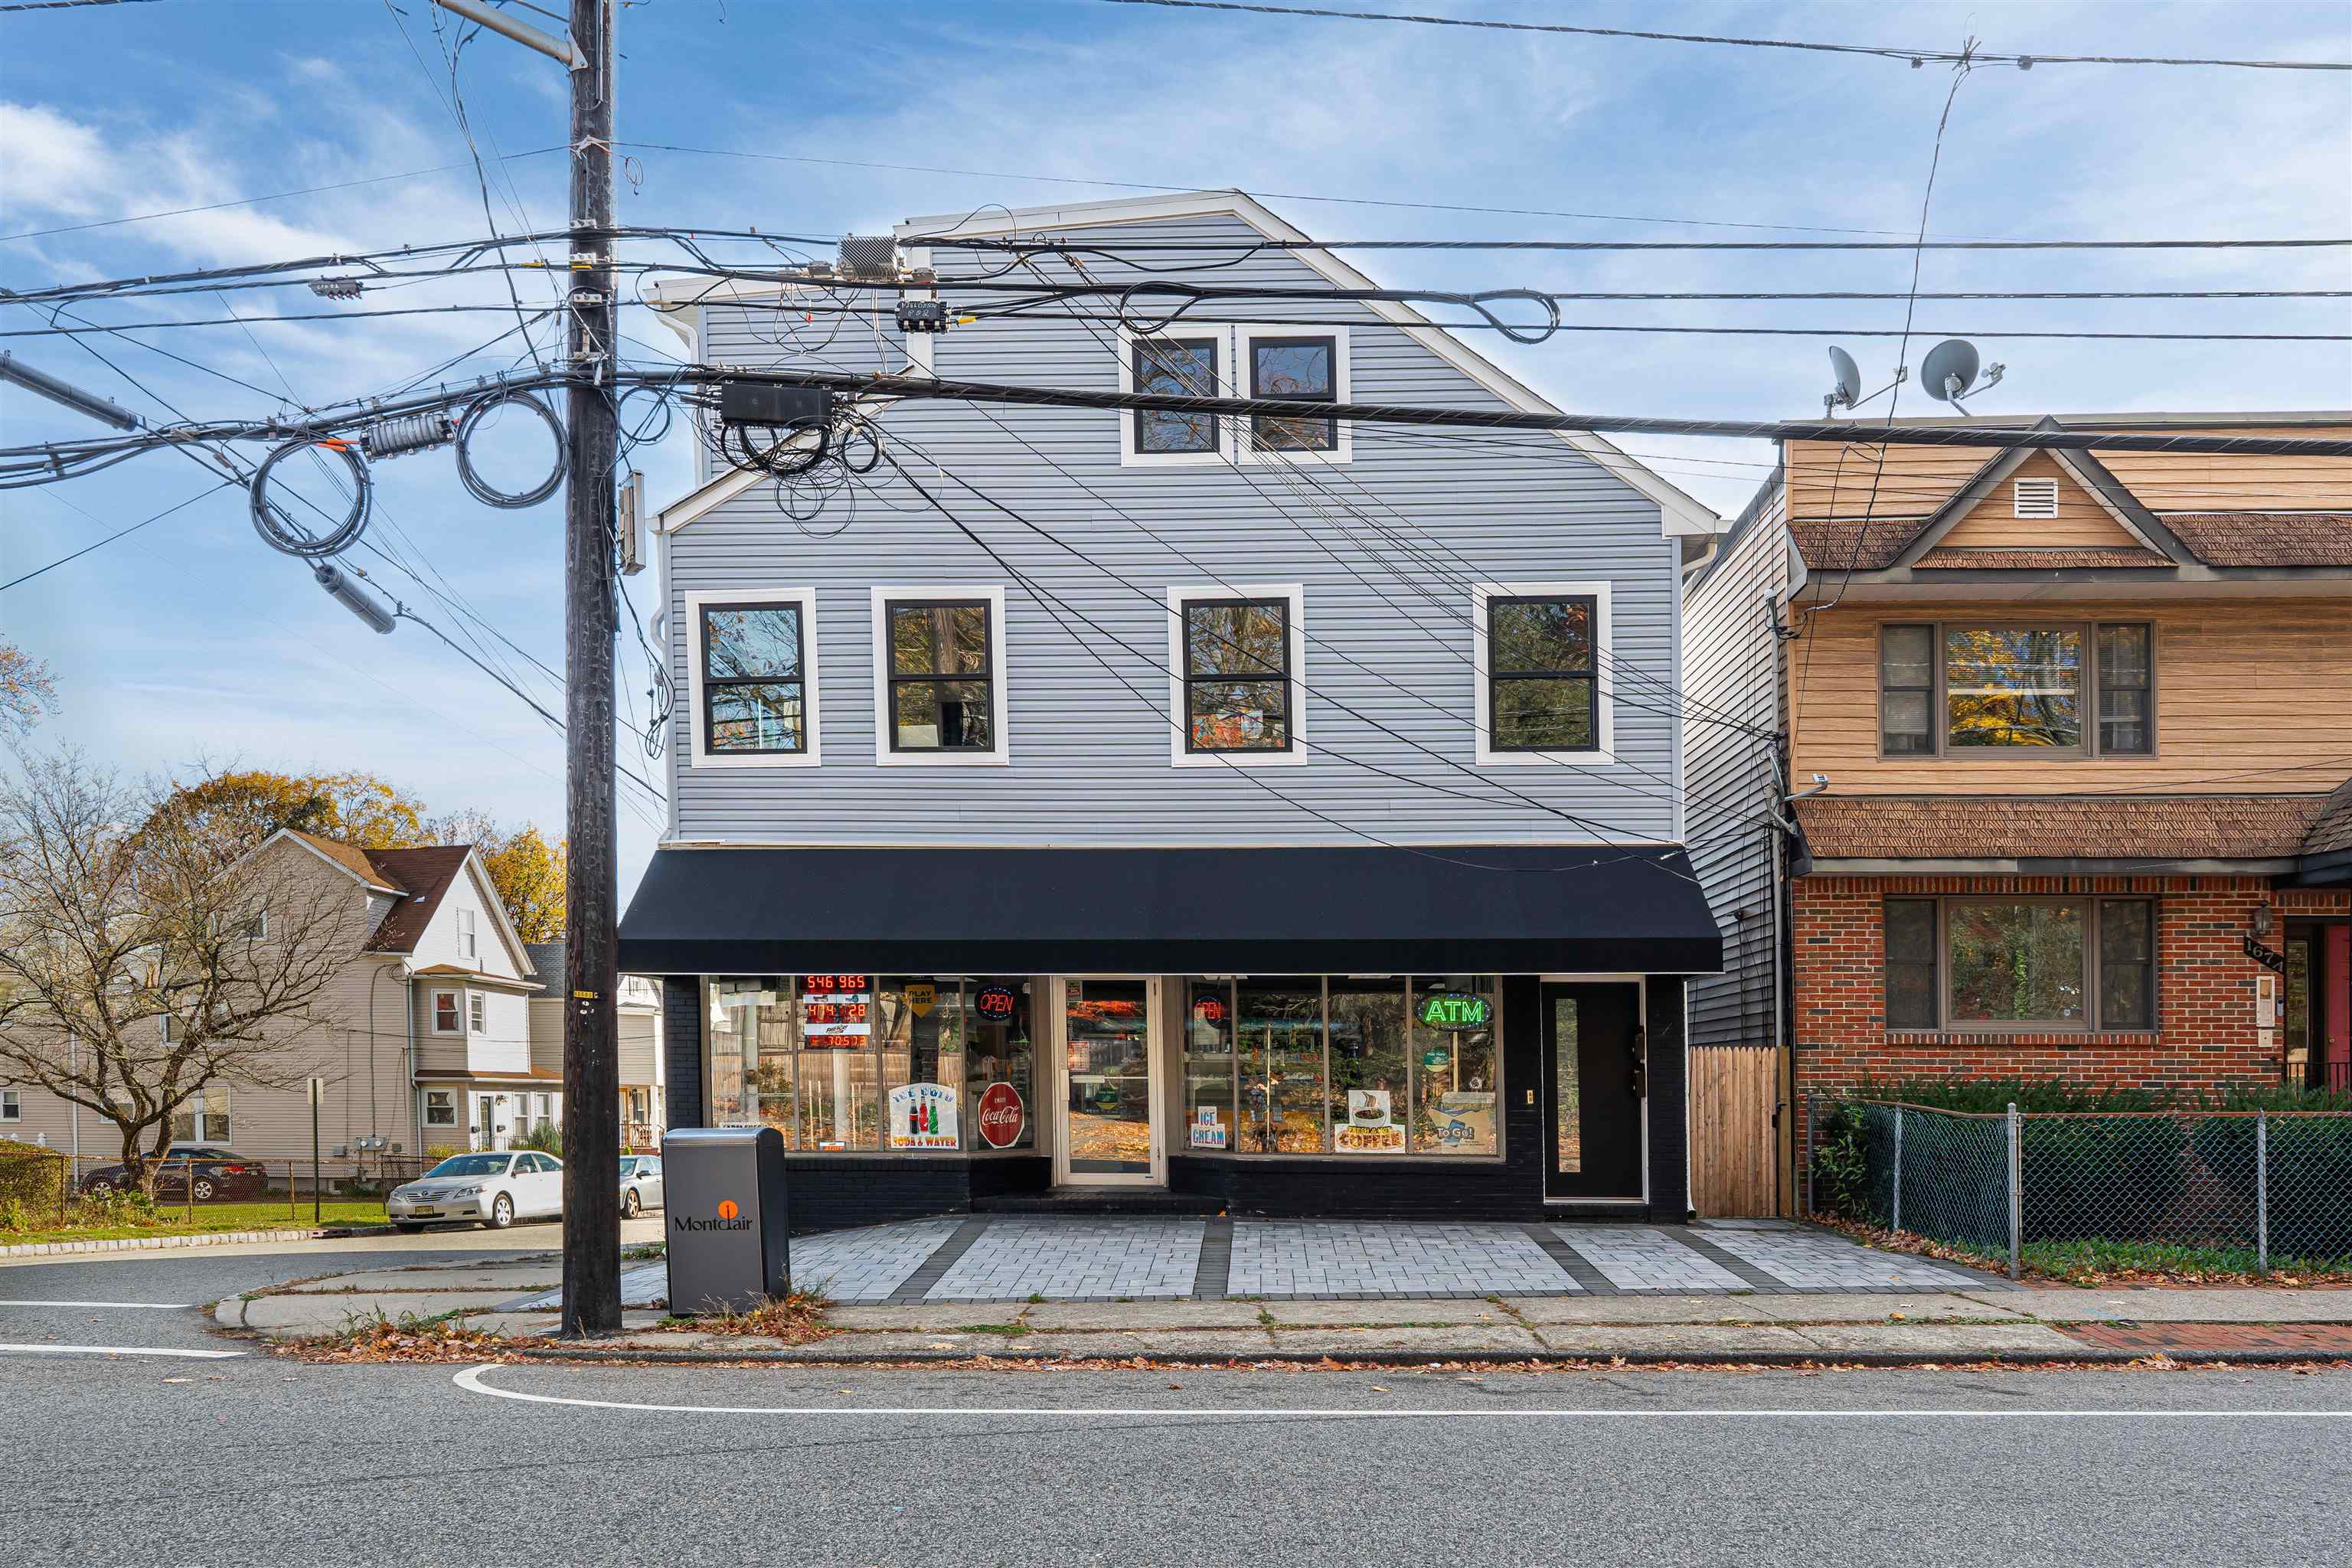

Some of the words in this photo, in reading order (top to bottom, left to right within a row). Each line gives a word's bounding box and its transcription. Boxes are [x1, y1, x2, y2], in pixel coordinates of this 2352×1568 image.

[808, 975, 833, 988] 546
[839, 975, 864, 988] 965
[979, 994, 1014, 1011] OPEN
[1426, 1001, 1483, 1021] ATM
[1200, 1112, 1216, 1126] ICE
[1193, 1129, 1225, 1145] CREAM
[1338, 1132, 1403, 1148] COFFEE
[1436, 1128, 1450, 1138] To
[1452, 1127, 1475, 1139] Go!
[924, 1136, 956, 1147] WATER
[675, 1204, 753, 1231] Montclair
